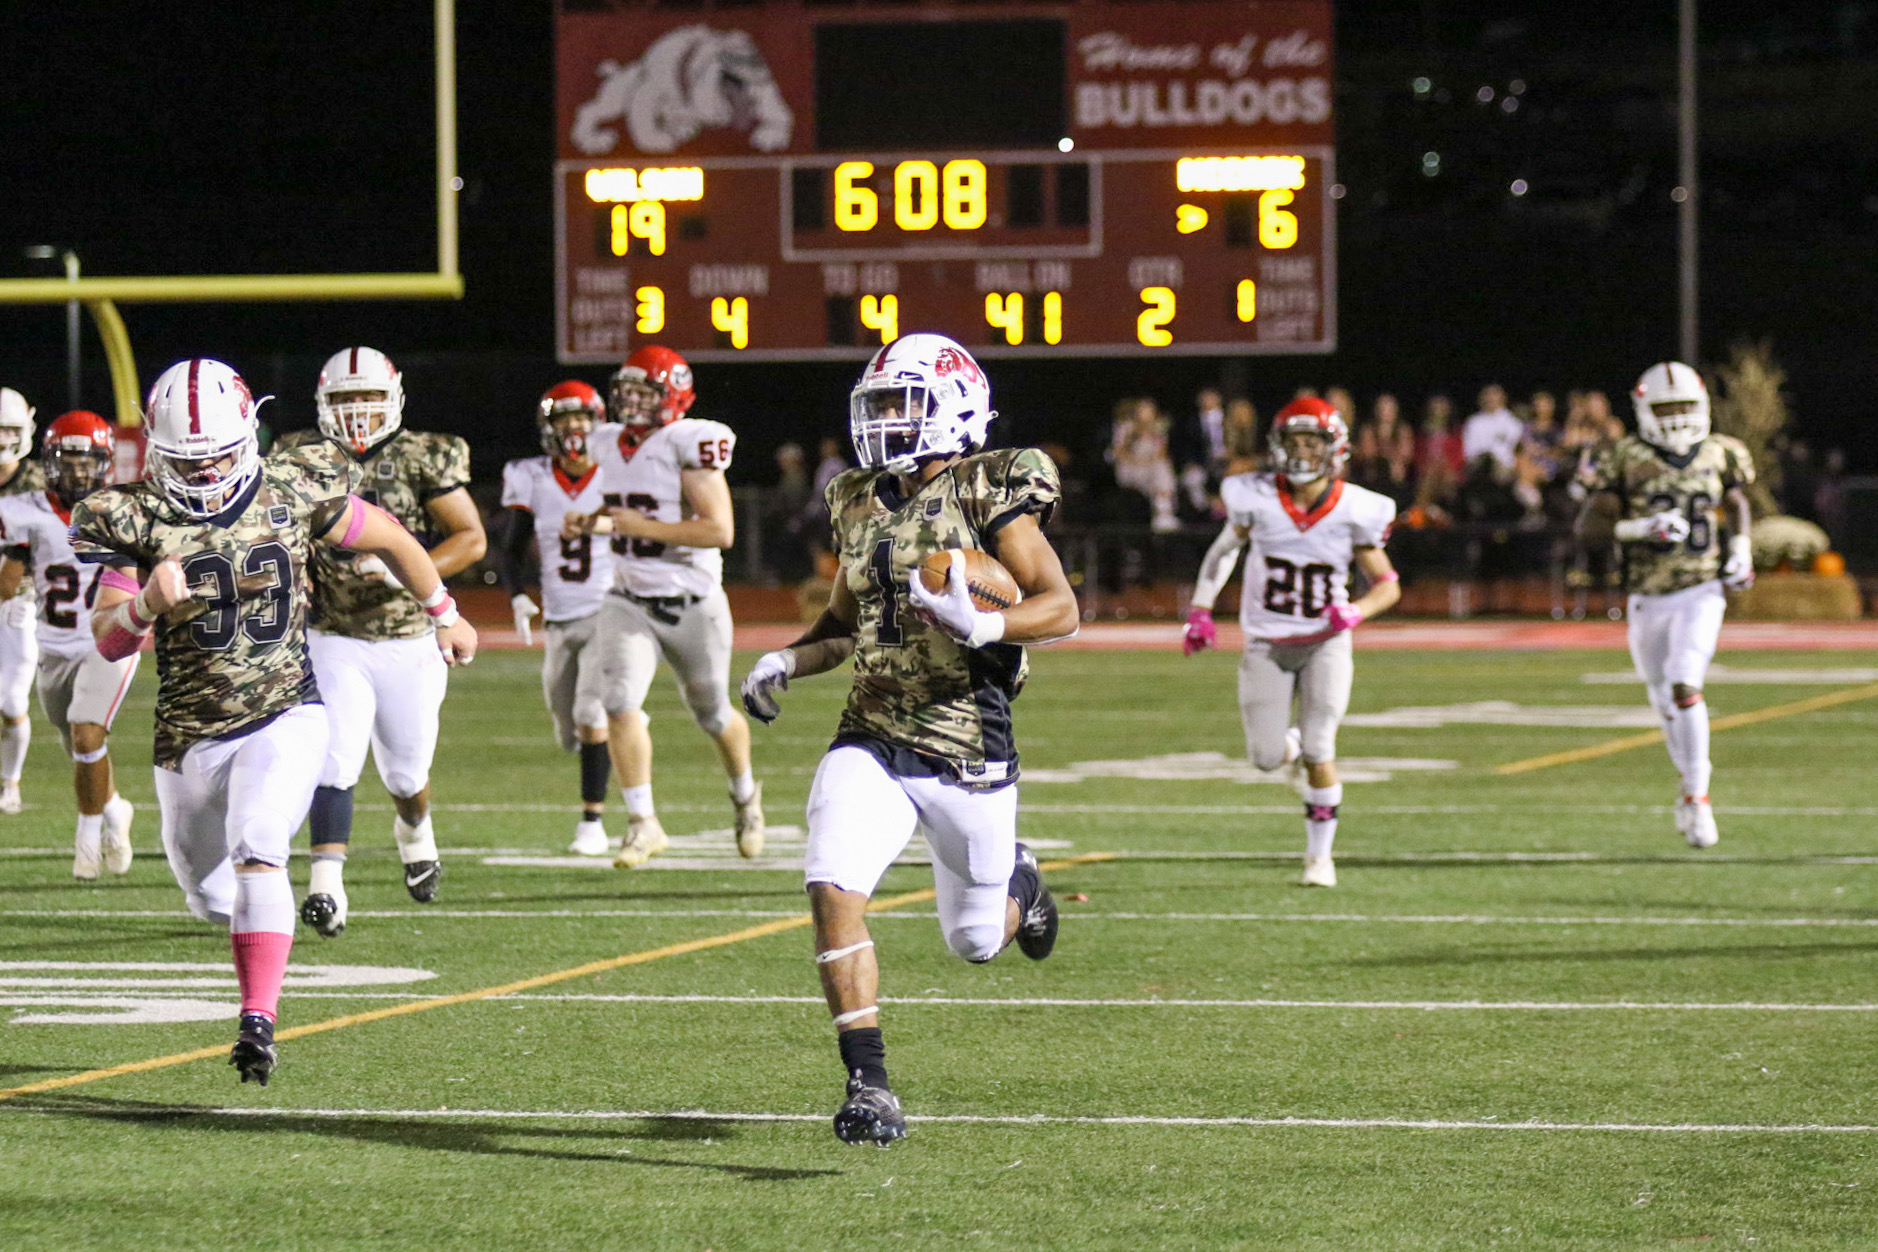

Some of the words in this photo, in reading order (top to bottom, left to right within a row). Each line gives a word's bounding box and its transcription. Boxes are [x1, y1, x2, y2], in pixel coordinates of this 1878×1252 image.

[1079, 32, 1201, 70] Home
[1209, 33, 1258, 77] of
[1263, 29, 1325, 67] the
[1075, 79, 1330, 127] BULLDOGS
[611, 202, 667, 256] 19
[1258, 189, 1299, 249] 6
[637, 287, 665, 334] 3
[712, 297, 749, 349] 4
[861, 295, 899, 345] 4
[1138, 287, 1176, 347] 2
[1238, 280, 1256, 323] 1
[698, 439, 731, 468] 56
[184, 540, 294, 651] 33
[867, 537, 904, 647] 1
[1264, 556, 1335, 618] 20
